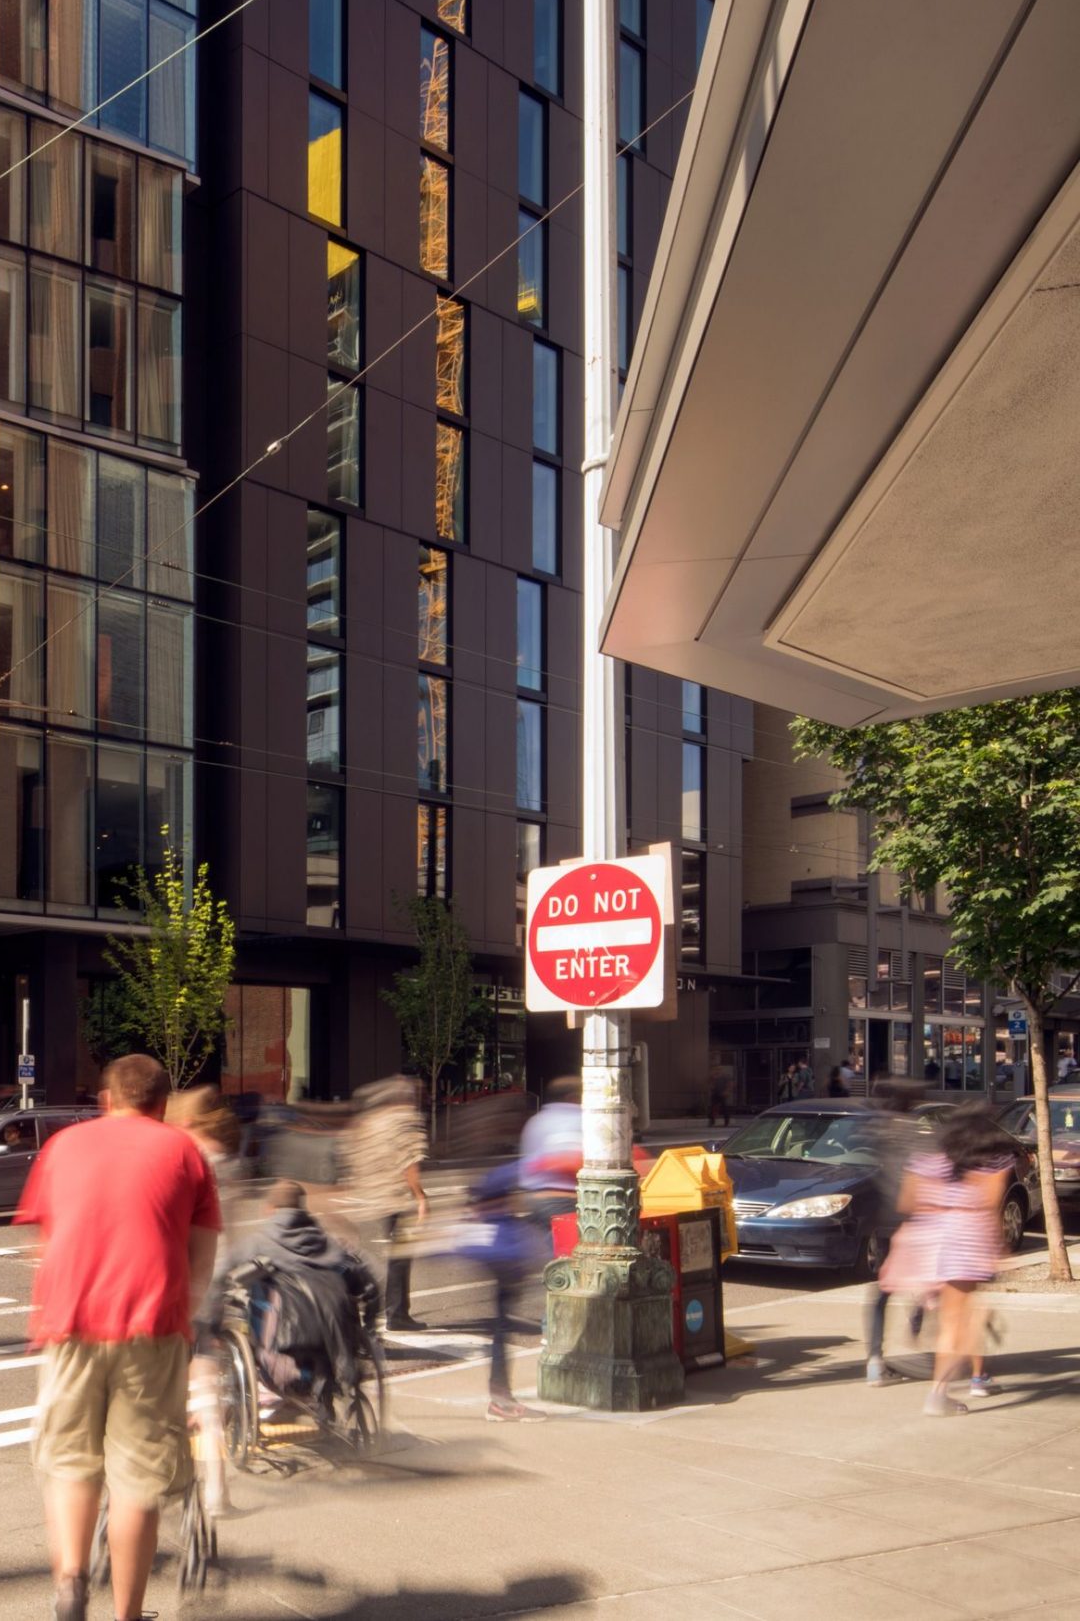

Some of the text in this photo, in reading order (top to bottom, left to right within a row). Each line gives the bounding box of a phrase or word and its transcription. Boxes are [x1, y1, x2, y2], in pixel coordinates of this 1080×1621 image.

[548, 888, 642, 918] DO NOT
[555, 954, 630, 980] ENTER
